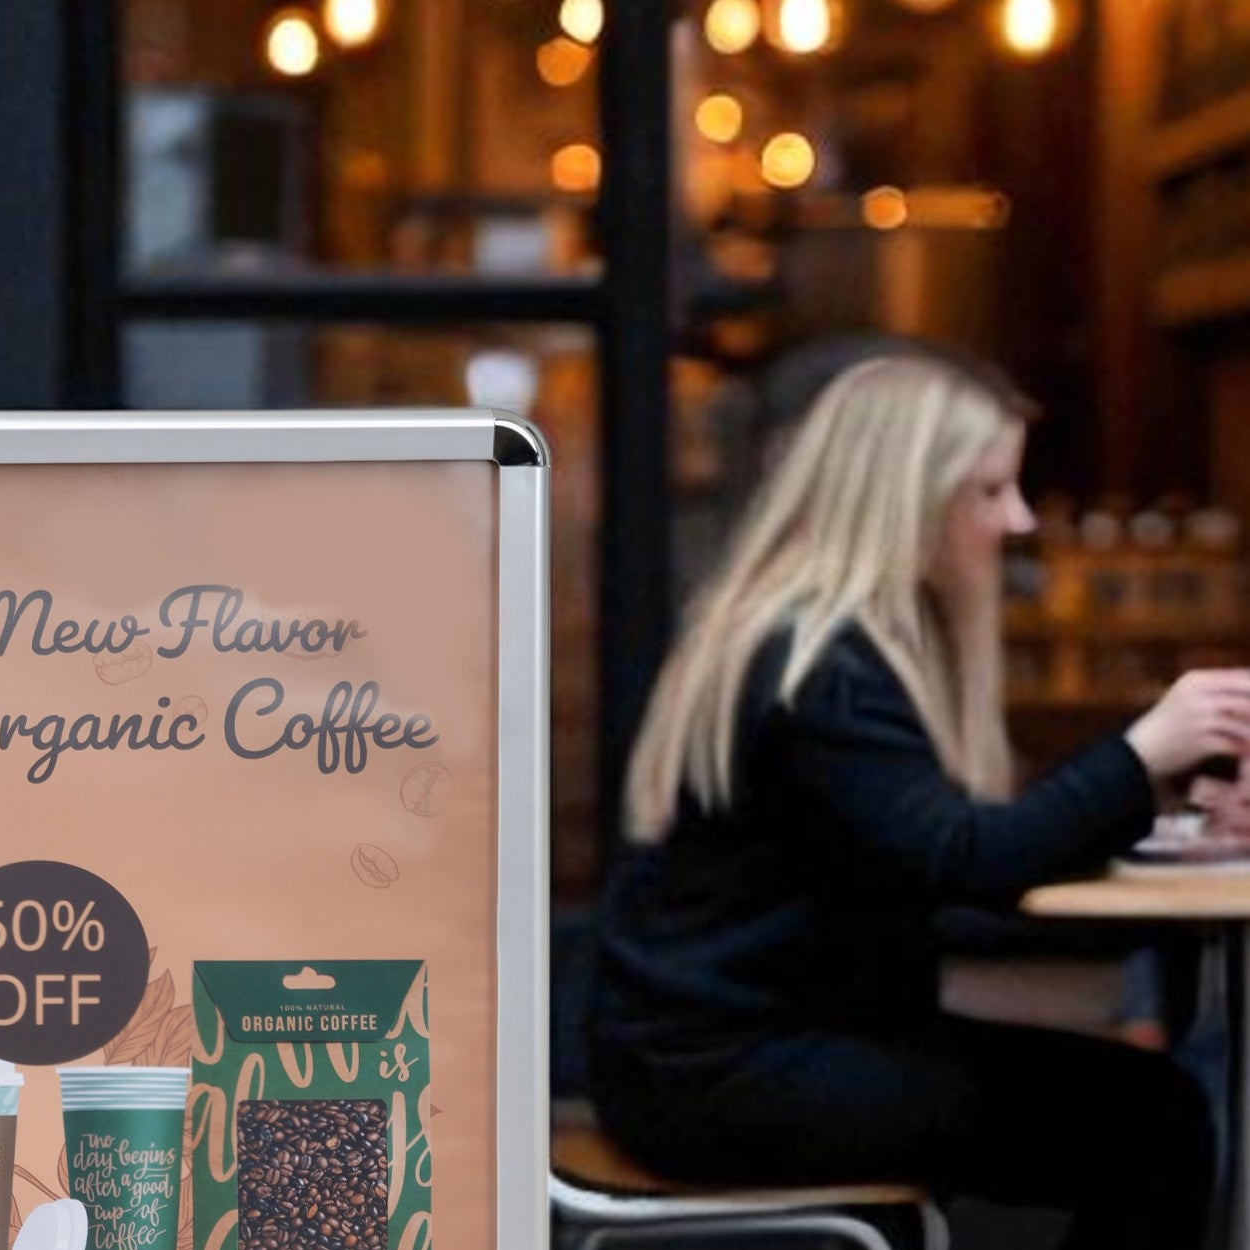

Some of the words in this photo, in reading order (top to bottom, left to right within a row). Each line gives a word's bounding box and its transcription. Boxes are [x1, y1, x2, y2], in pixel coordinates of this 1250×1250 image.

[156, 584, 368, 659] Flavor
[223, 677, 440, 775] Coffee
[241, 1015, 314, 1032] ORGANIC
[320, 1014, 378, 1031] COFFEE
[280, 1004, 303, 1012] 100%
[306, 1004, 346, 1012] NATURAL
[379, 1043, 419, 1081] is
[73, 1141, 118, 1178] day
[114, 1139, 175, 1180] begins
[74, 1170, 121, 1203] after
[121, 1173, 131, 1187] a
[128, 1173, 174, 1208] good
